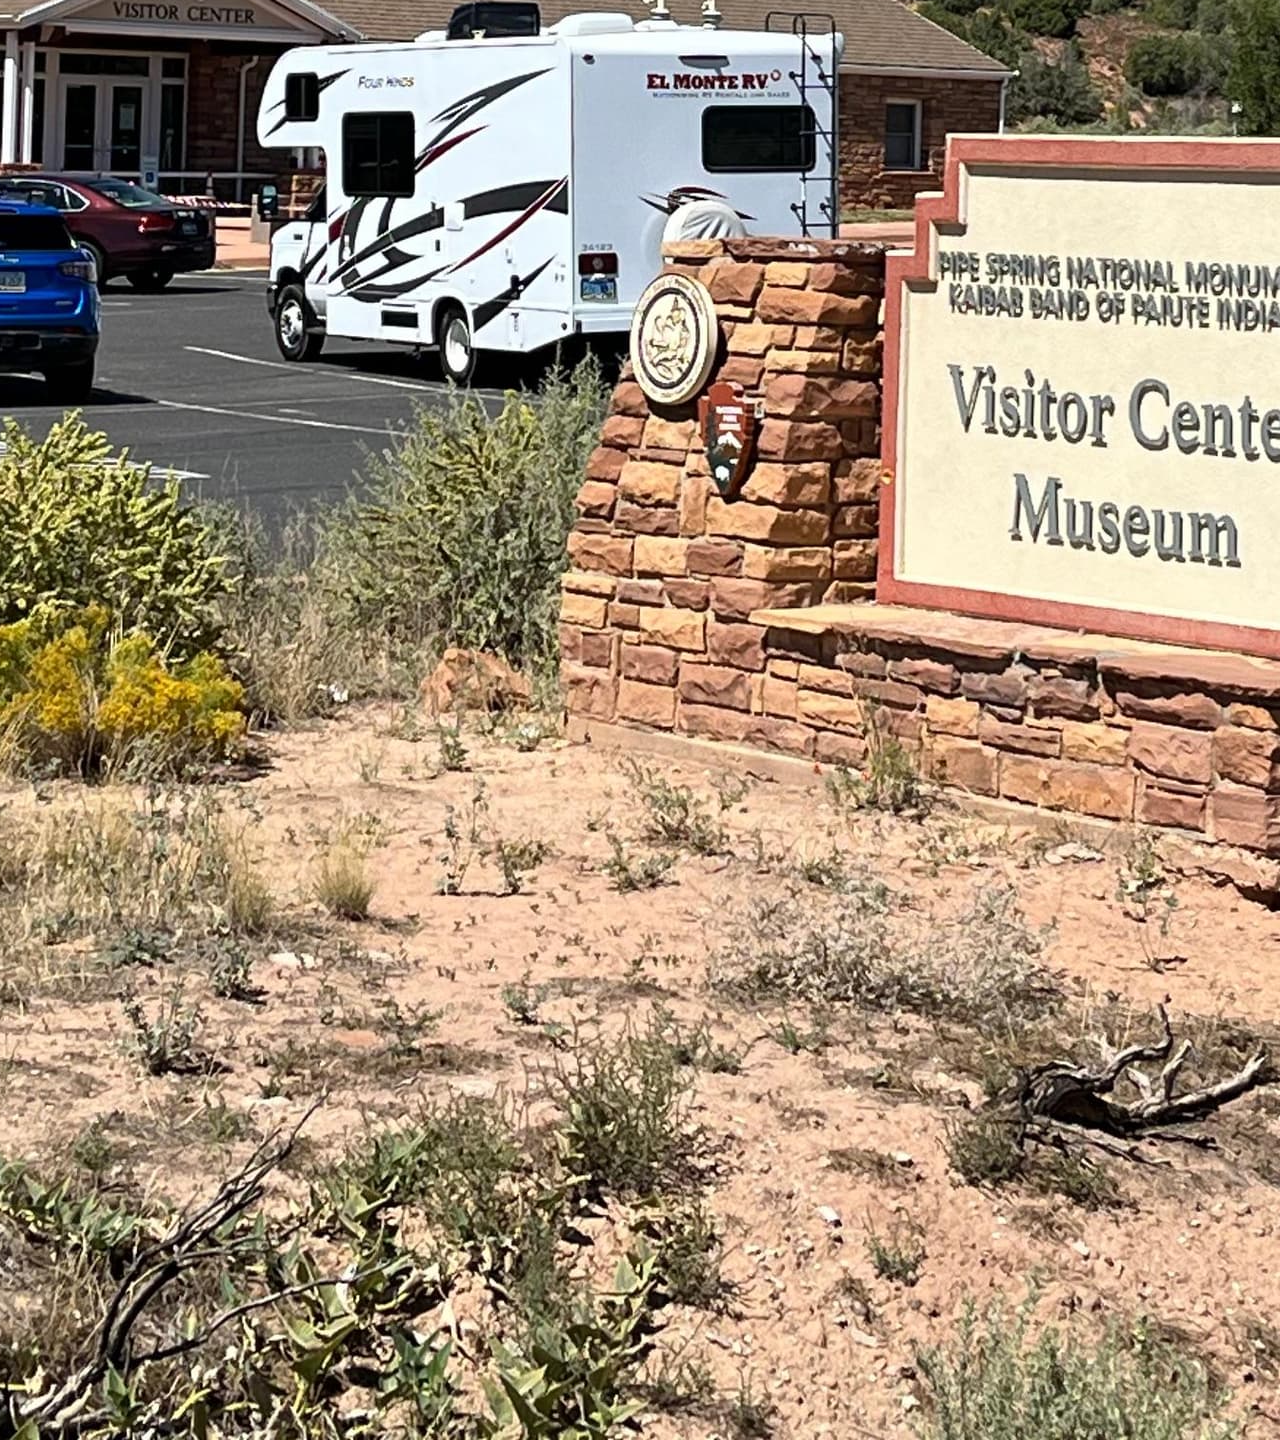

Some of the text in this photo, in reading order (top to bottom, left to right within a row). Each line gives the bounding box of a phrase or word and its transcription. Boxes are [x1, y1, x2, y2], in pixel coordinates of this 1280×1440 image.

[113, 1, 255, 24] VISITOR CENTER
[647, 73, 769, 89] EL MONTE RV
[938, 251, 980, 282] PIPE
[985, 252, 1061, 287] SPRING
[1066, 256, 1180, 294] NATIONAL
[949, 282, 1023, 317] KAIBAB
[1029, 287, 1090, 321] BAND
[1095, 291, 1126, 325] OF
[1131, 293, 1210, 329] PAIUTE
[947, 363, 1115, 447] Visitor
[1008, 472, 1242, 568] Museum
